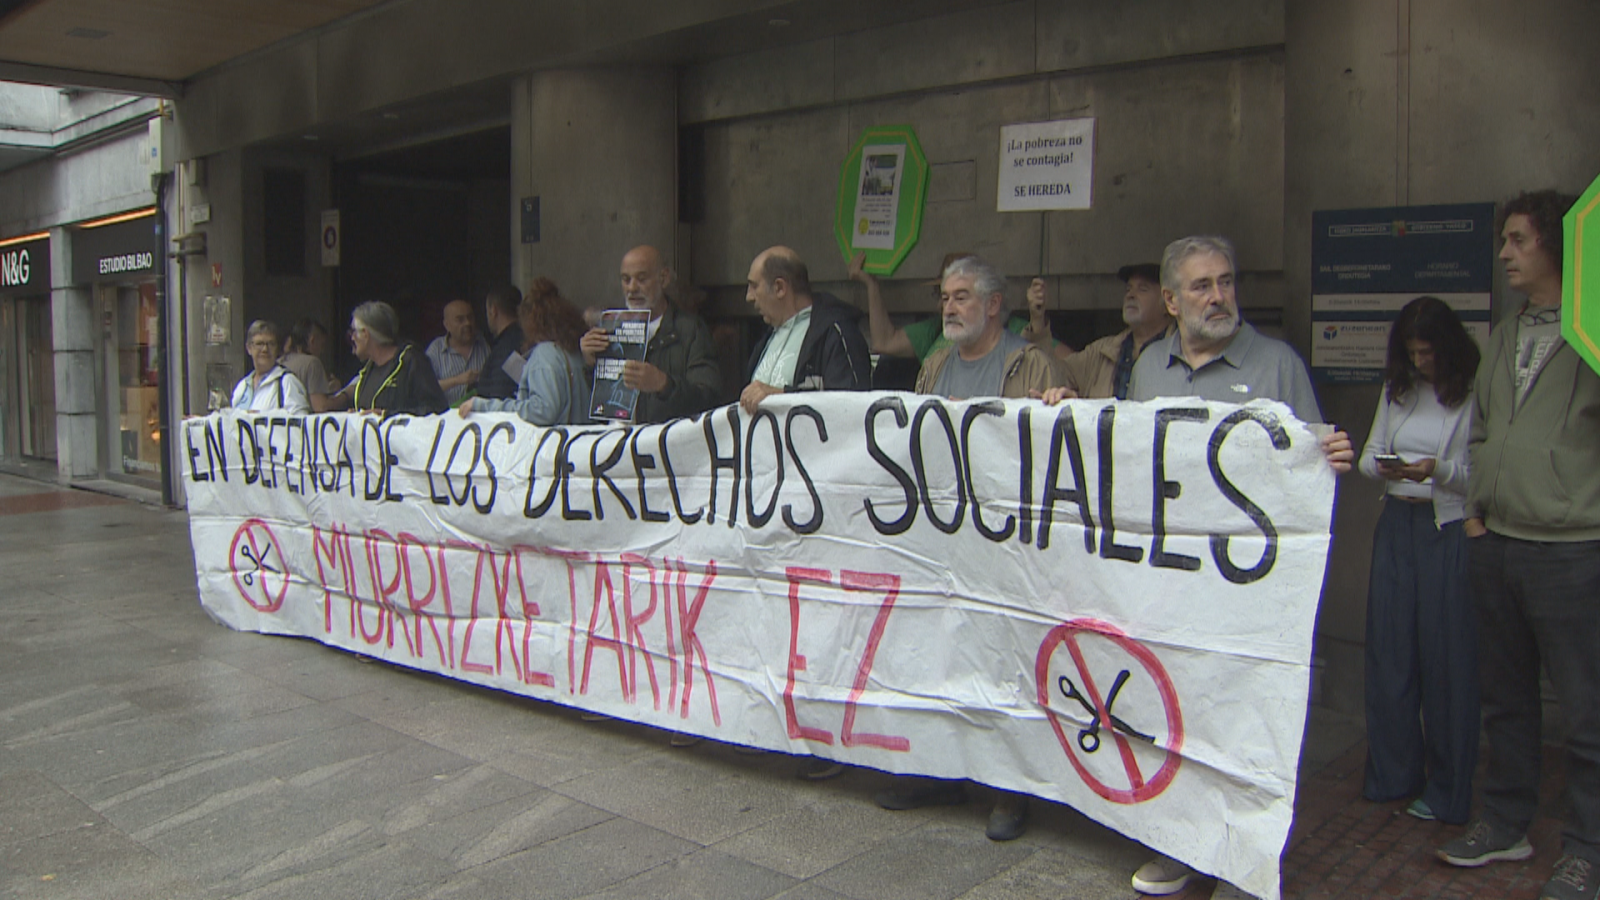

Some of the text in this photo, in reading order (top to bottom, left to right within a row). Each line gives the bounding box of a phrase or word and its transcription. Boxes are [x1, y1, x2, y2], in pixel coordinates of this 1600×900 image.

[1007, 135, 1082, 153] ¡La pobreza no
[1013, 152, 1074, 167] se contagia!
[1014, 183, 1071, 197] SE HEREDA
[1, 249, 30, 287] N&G
[99, 252, 152, 274] ESTUDIO BILBAO
[185, 396, 1291, 584] EN DEFENSA DE LOS DERECHOS SOCIALES
[313, 521, 910, 752] MURRIZKETARIK EZ
